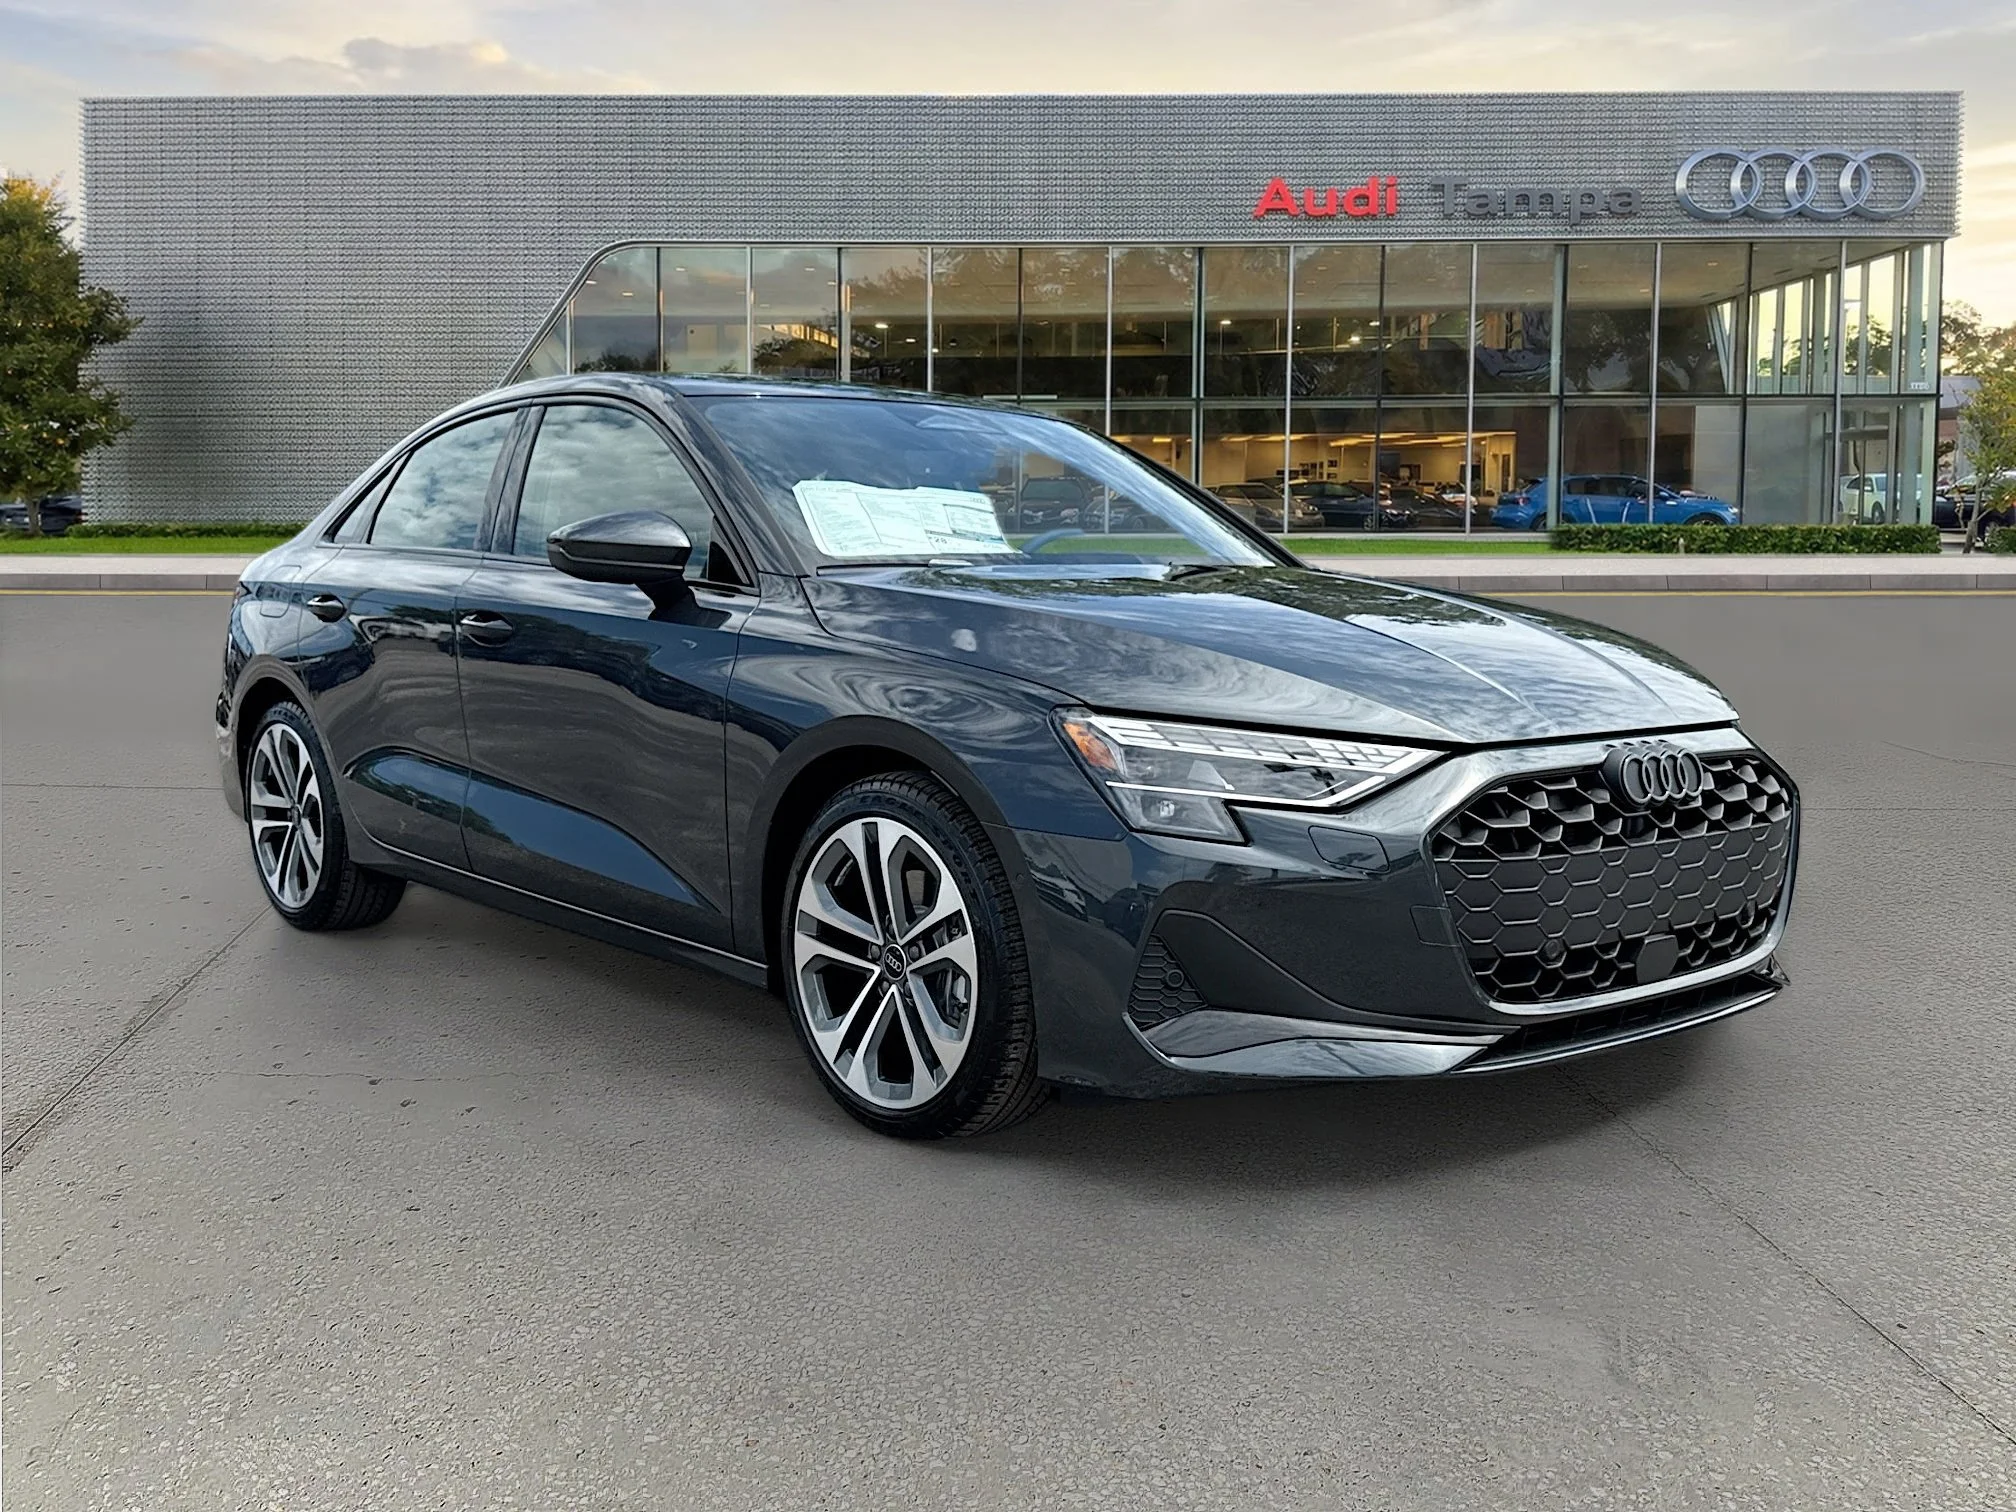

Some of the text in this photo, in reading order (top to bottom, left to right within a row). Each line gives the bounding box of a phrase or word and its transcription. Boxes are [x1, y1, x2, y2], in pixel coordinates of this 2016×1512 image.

[1253, 175, 1642, 226] Audi Tampa
[859, 795, 926, 819] EAGLE
